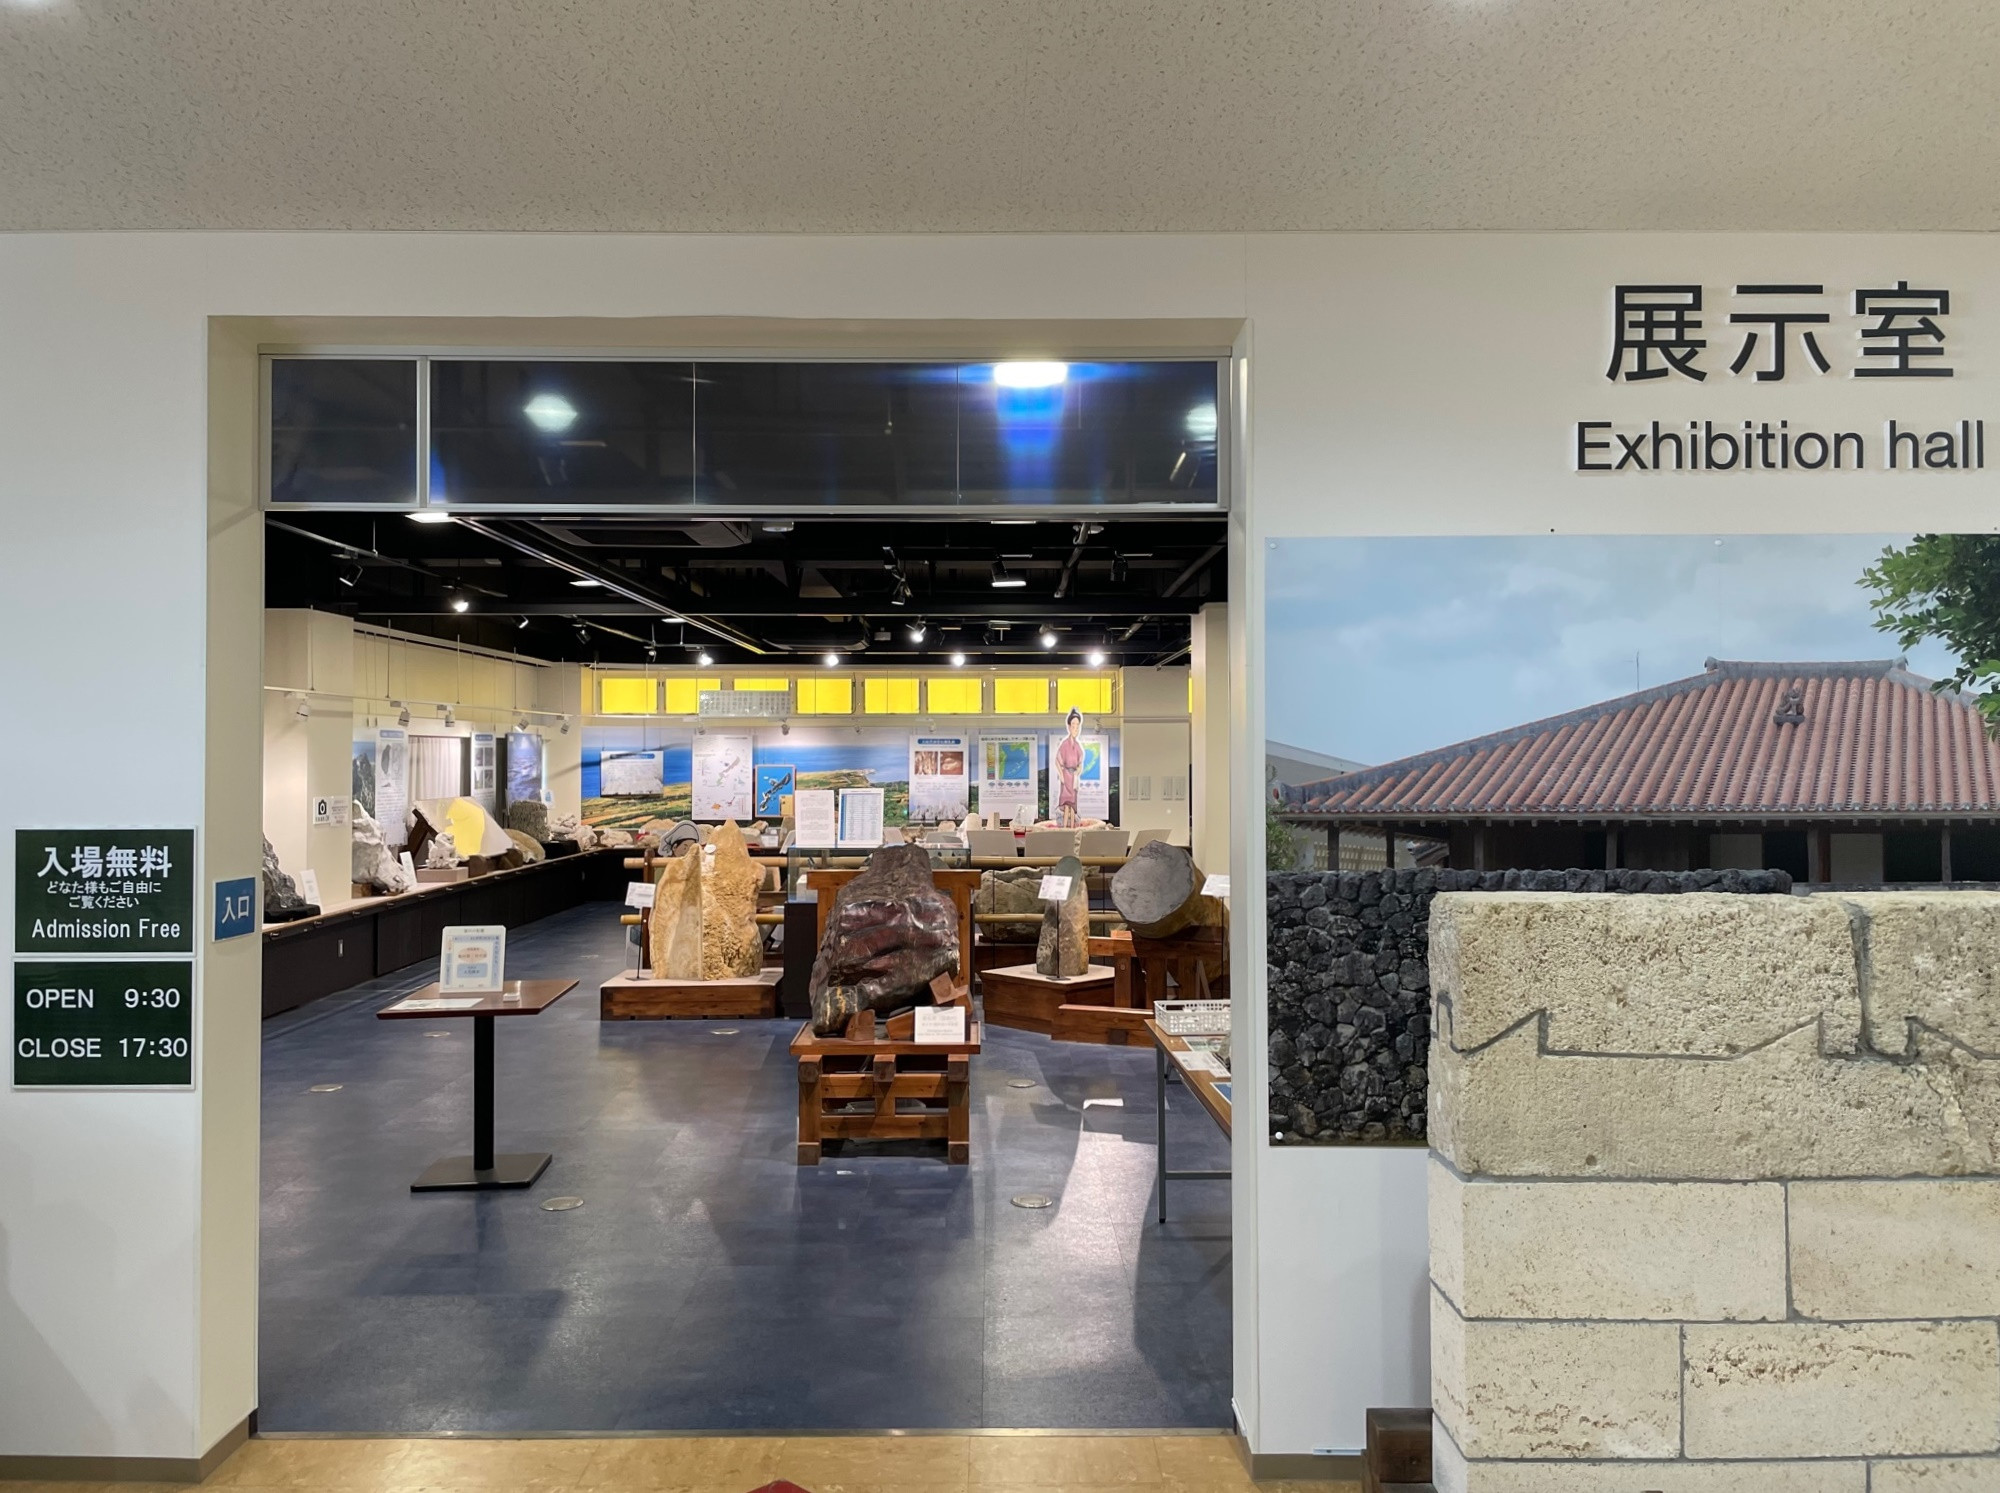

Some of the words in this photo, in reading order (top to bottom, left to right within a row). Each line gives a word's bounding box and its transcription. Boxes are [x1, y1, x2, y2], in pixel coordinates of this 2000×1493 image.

[1606, 281, 1954, 382] 展示室
[1577, 420, 1864, 470] Exhibition
[1890, 420, 1984, 469] hall
[37, 846, 173, 878] 入場無料
[47, 881, 162, 894] どなた様もご自由に
[69, 896, 140, 909] ご覧ください
[221, 896, 250, 924] 入口
[32, 919, 130, 938] Admission
[139, 919, 180, 938] Free
[26, 989, 94, 1009] OPEN
[124, 988, 180, 1008] 9:30
[18, 1038, 102, 1058] CLOSE
[119, 1038, 188, 1058] 17:30
